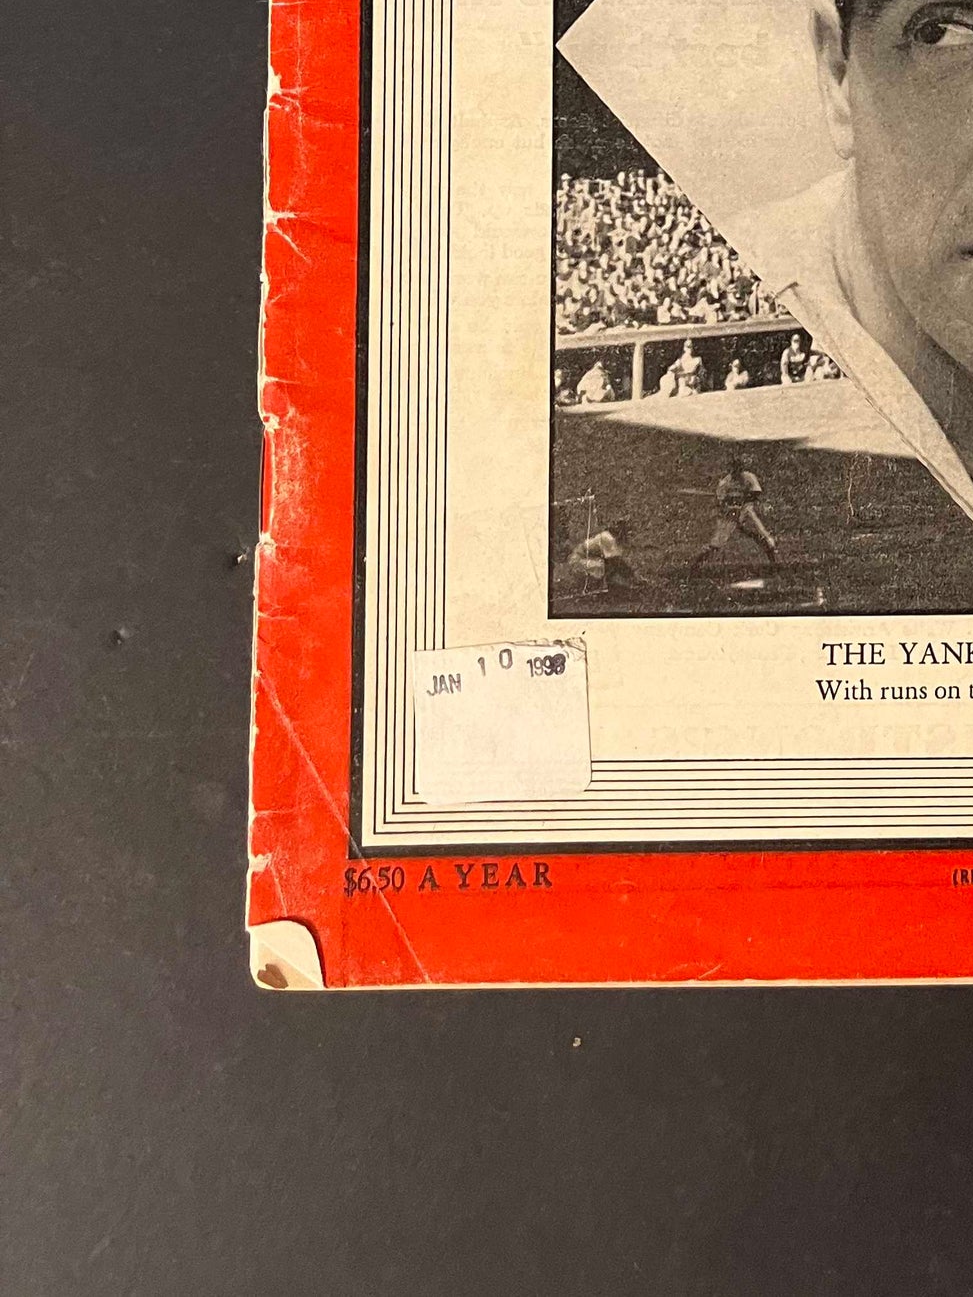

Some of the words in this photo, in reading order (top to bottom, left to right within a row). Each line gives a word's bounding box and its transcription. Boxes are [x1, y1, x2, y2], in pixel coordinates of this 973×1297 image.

[822, 642, 886, 666] THE
[426, 673, 462, 696] JAN
[816, 678, 873, 701] With
[880, 685, 927, 700] runs
[934, 685, 961, 700] on
[343, 865, 405, 897] $6.50
[418, 865, 441, 891] A
[454, 862, 552, 891] YEAR
